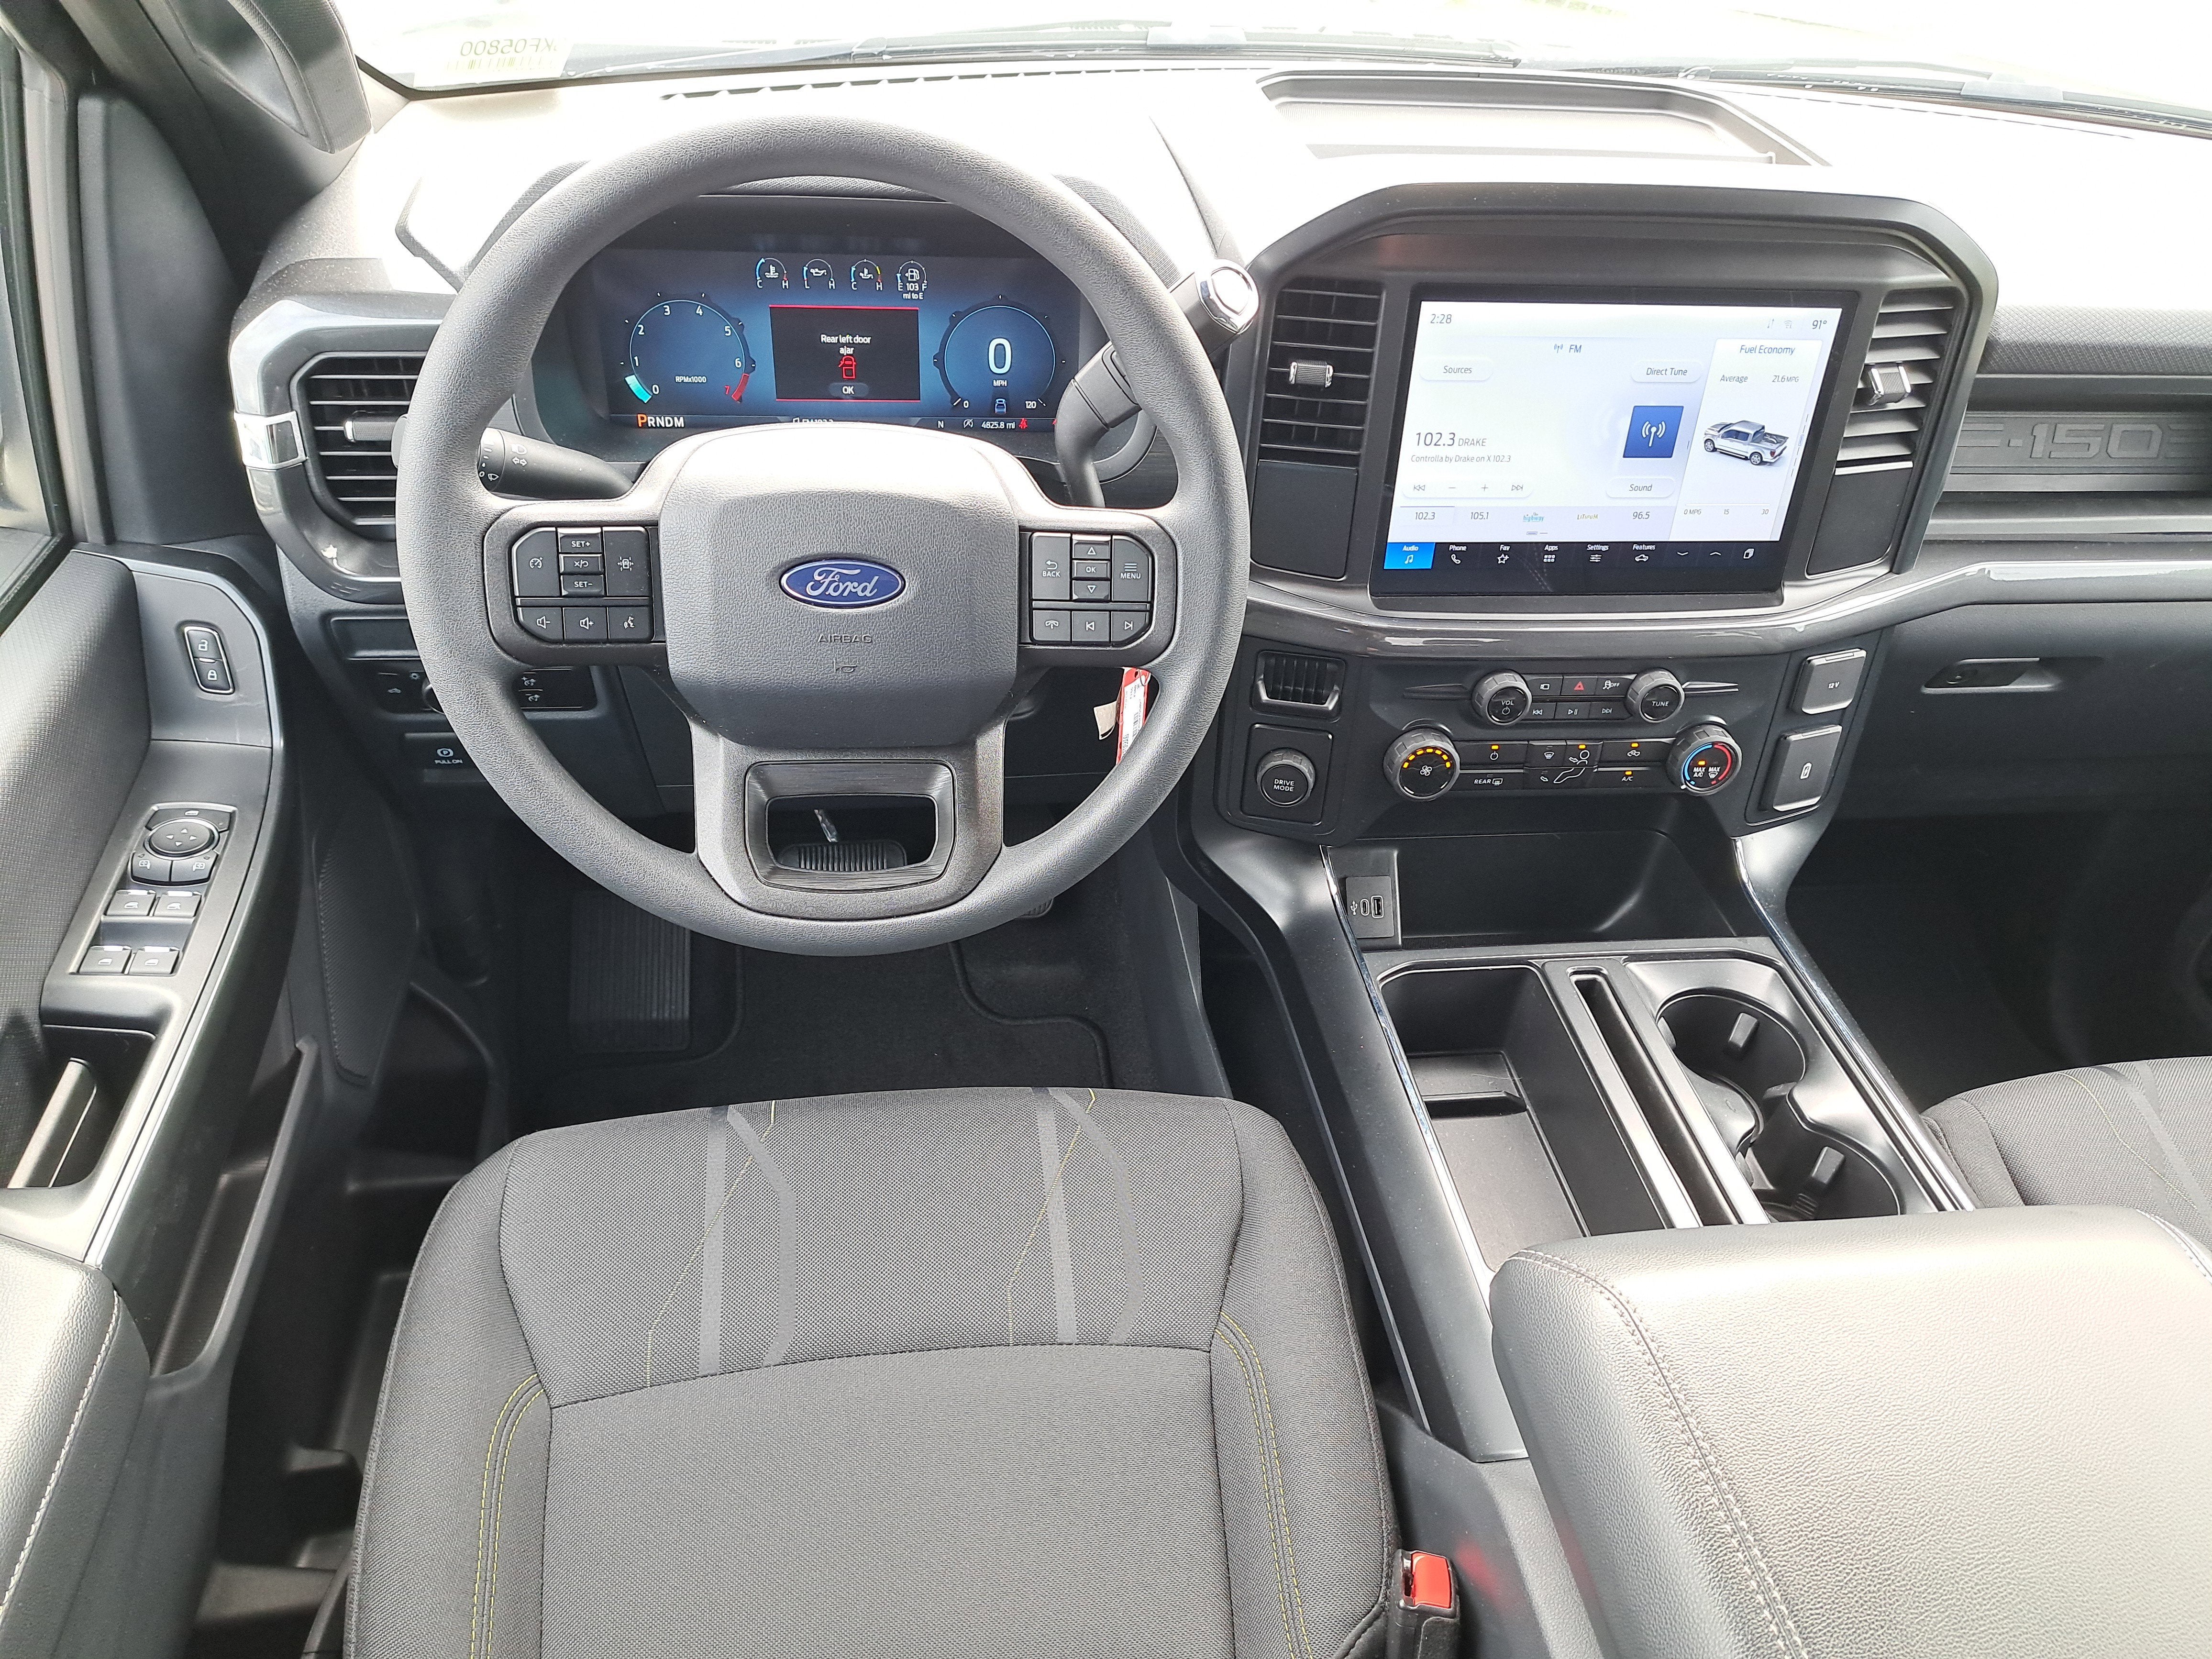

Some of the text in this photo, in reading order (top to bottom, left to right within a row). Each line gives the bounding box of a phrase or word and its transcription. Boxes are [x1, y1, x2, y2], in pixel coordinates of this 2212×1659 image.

[757, 280, 763, 288] C
[782, 280, 789, 289] H
[804, 280, 810, 289] L
[829, 280, 835, 289] H
[852, 281, 857, 290] C
[876, 282, 883, 290] H
[898, 283, 903, 291] E
[906, 283, 919, 291] 103
[922, 283, 927, 291] F
[664, 305, 671, 316] 3
[696, 305, 703, 316] 4
[1430, 313, 1452, 324] 2:28
[638, 325, 644, 335] 2
[724, 326, 731, 336] 5
[820, 334, 871, 343] Rear left door
[839, 345, 854, 355] ajar
[1568, 344, 1582, 354] FM
[1739, 345, 1796, 355] Fuel Economy
[987, 336, 1012, 375] 0
[634, 356, 639, 366] 1
[735, 358, 742, 368] 6
[1443, 365, 1472, 374] Sources
[1646, 367, 1688, 376] Direct Tune
[993, 379, 1007, 387] MPH
[1720, 374, 1748, 384] Average
[653, 384, 660, 395] 0
[725, 386, 730, 395] 7
[842, 386, 855, 395] OK
[963, 400, 969, 409] 0
[1025, 400, 1037, 409] 120
[981, 421, 1005, 429] 4825.8
[1415, 432, 1487, 447] 102.3 DRAKE
[1411, 454, 1443, 463] Controlla
[1445, 454, 1453, 464] by
[1628, 483, 1653, 492] Sound
[1415, 511, 1436, 520] 102.3
[1470, 511, 1489, 520] 105.1
[1632, 511, 1650, 520] 96.5
[1449, 544, 1467, 552] Phone
[1545, 544, 1559, 553] Apps
[1586, 544, 1609, 552] Settings
[806, 566, 880, 597] Ford
[817, 633, 873, 644] AIRBAG
